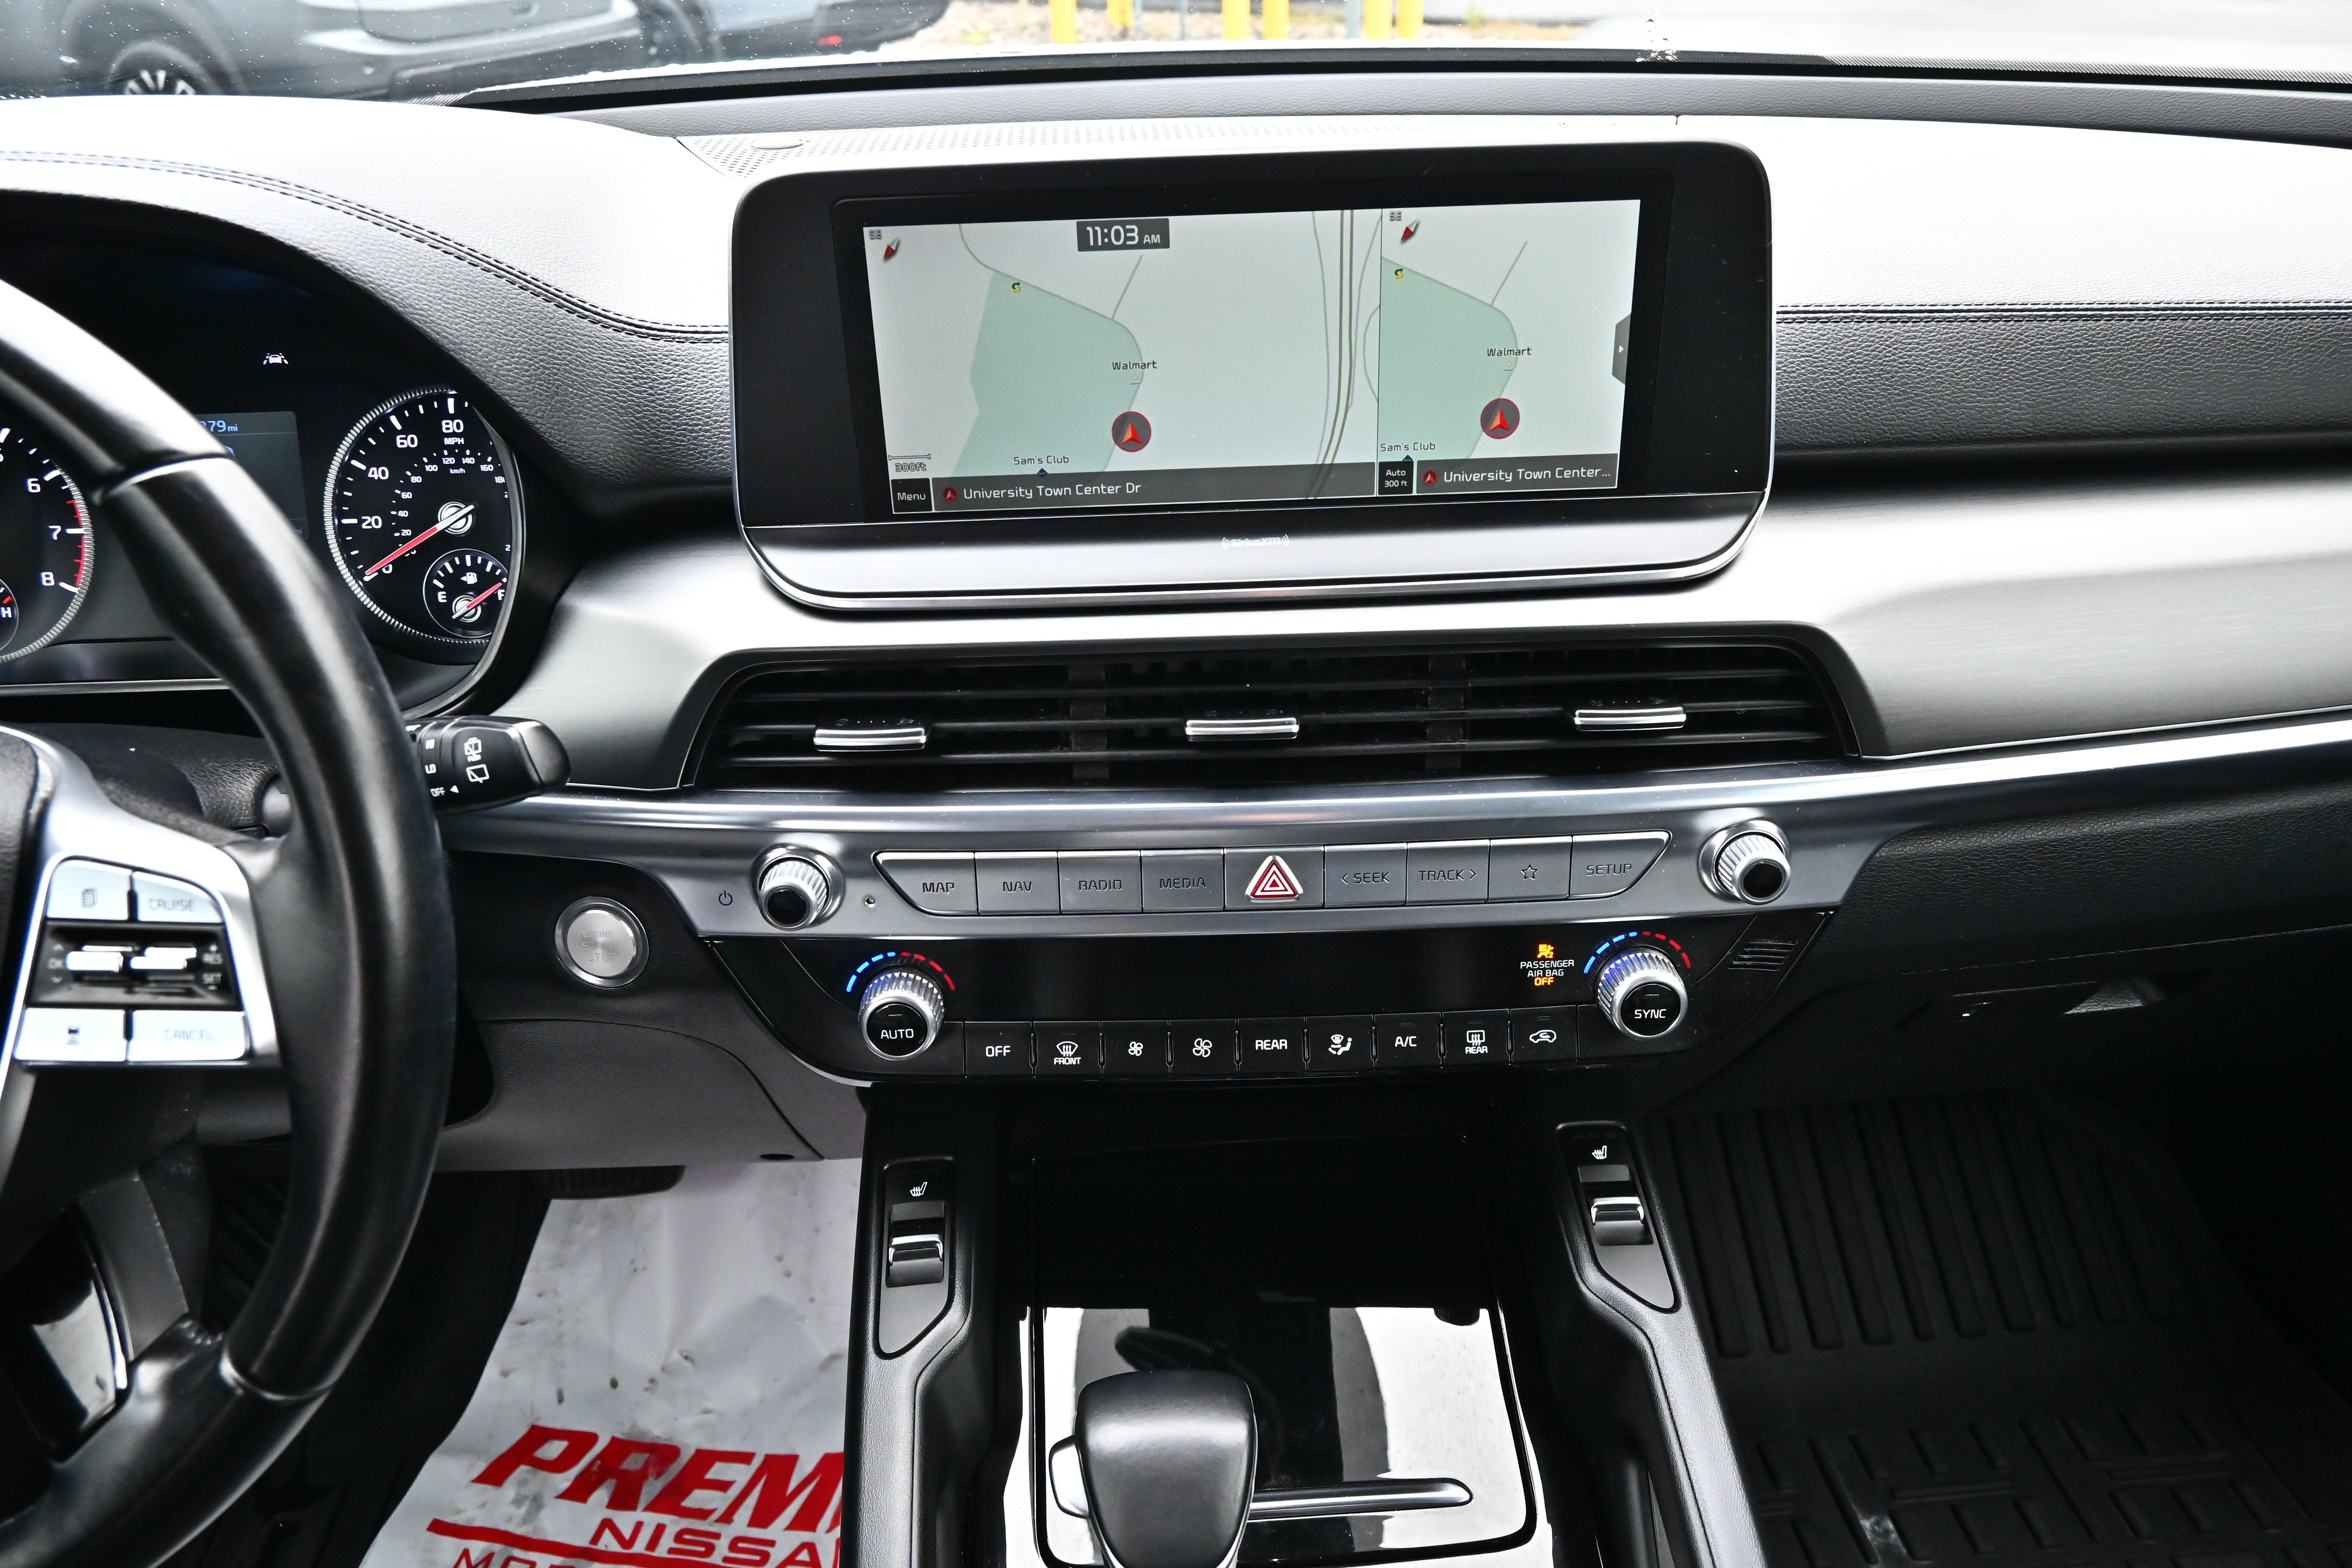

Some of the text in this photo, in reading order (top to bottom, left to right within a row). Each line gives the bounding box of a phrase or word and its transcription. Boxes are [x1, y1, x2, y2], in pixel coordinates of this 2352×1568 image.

[1389, 211, 1402, 221] SE
[868, 229, 882, 240] SE
[1086, 225, 1161, 247] 11:03 AM
[1486, 346, 1532, 357] Walmart
[1112, 360, 1157, 370] Walmart
[442, 419, 464, 433] 80
[396, 434, 418, 448] 60
[444, 437, 464, 445] MPH
[1380, 441, 1436, 452] Sam's Club
[1013, 455, 1070, 465] Sam's Club
[368, 467, 389, 480] 40
[1386, 468, 1406, 477] Auto
[1444, 470, 1512, 483] University
[1517, 468, 1551, 480] Town
[27, 478, 41, 493] 6
[1384, 479, 1399, 487] 300
[897, 491, 926, 501] Menu
[964, 483, 1142, 500] University Town Center Dr
[362, 516, 382, 528] 20
[49, 525, 61, 540] 7
[41, 572, 55, 586] 8
[438, 591, 446, 602] E
[498, 589, 505, 600] F
[1, 607, 12, 618] H
[430, 787, 445, 797] OFF
[1586, 863, 1632, 876] SETUP
[1353, 872, 1390, 885] SEEK
[1418, 869, 1465, 882] TRACK
[922, 882, 955, 893] MAP
[1002, 881, 1032, 892] NAV
[1078, 879, 1122, 891] RADIO
[1160, 878, 1206, 890] MEDIA
[1520, 959, 1574, 969] PASSENGER
[1527, 968, 1564, 977] AIR BAG
[1534, 977, 1554, 986] OFF
[1634, 1008, 1666, 1019] SYNC
[164, 1028, 215, 1042] CANCEL
[880, 1028, 914, 1040] AUTO
[1255, 1039, 1288, 1050] REAR
[1394, 1036, 1417, 1048] A/C
[985, 1045, 1011, 1057] OFF
[1465, 1046, 1488, 1054] REAR
[1054, 1057, 1081, 1065] FRONT
[470, 1424, 844, 1534] PREM
